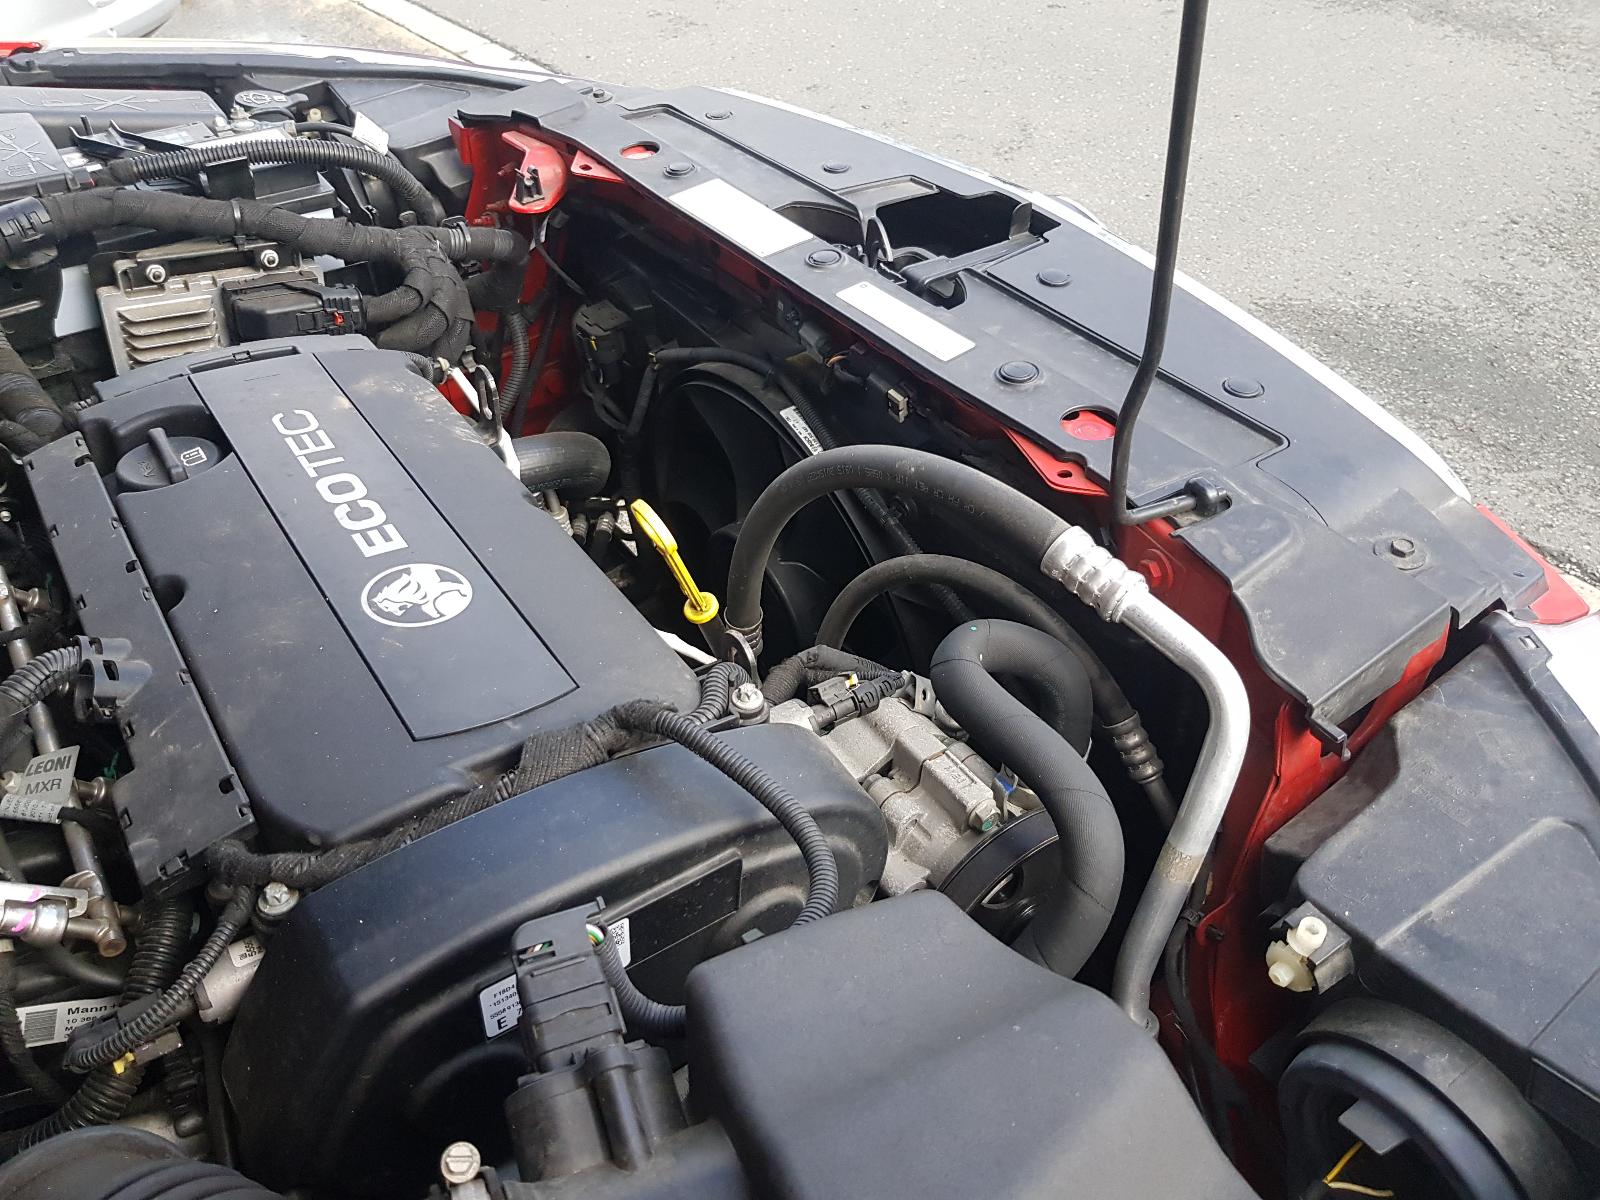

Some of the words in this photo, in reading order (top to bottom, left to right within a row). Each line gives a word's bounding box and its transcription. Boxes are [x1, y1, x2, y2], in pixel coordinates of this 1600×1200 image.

[271, 409, 409, 558] ECOTEC
[25, 754, 73, 777] LEONI
[24, 778, 63, 796] MXR
[496, 1015, 509, 1031] E
